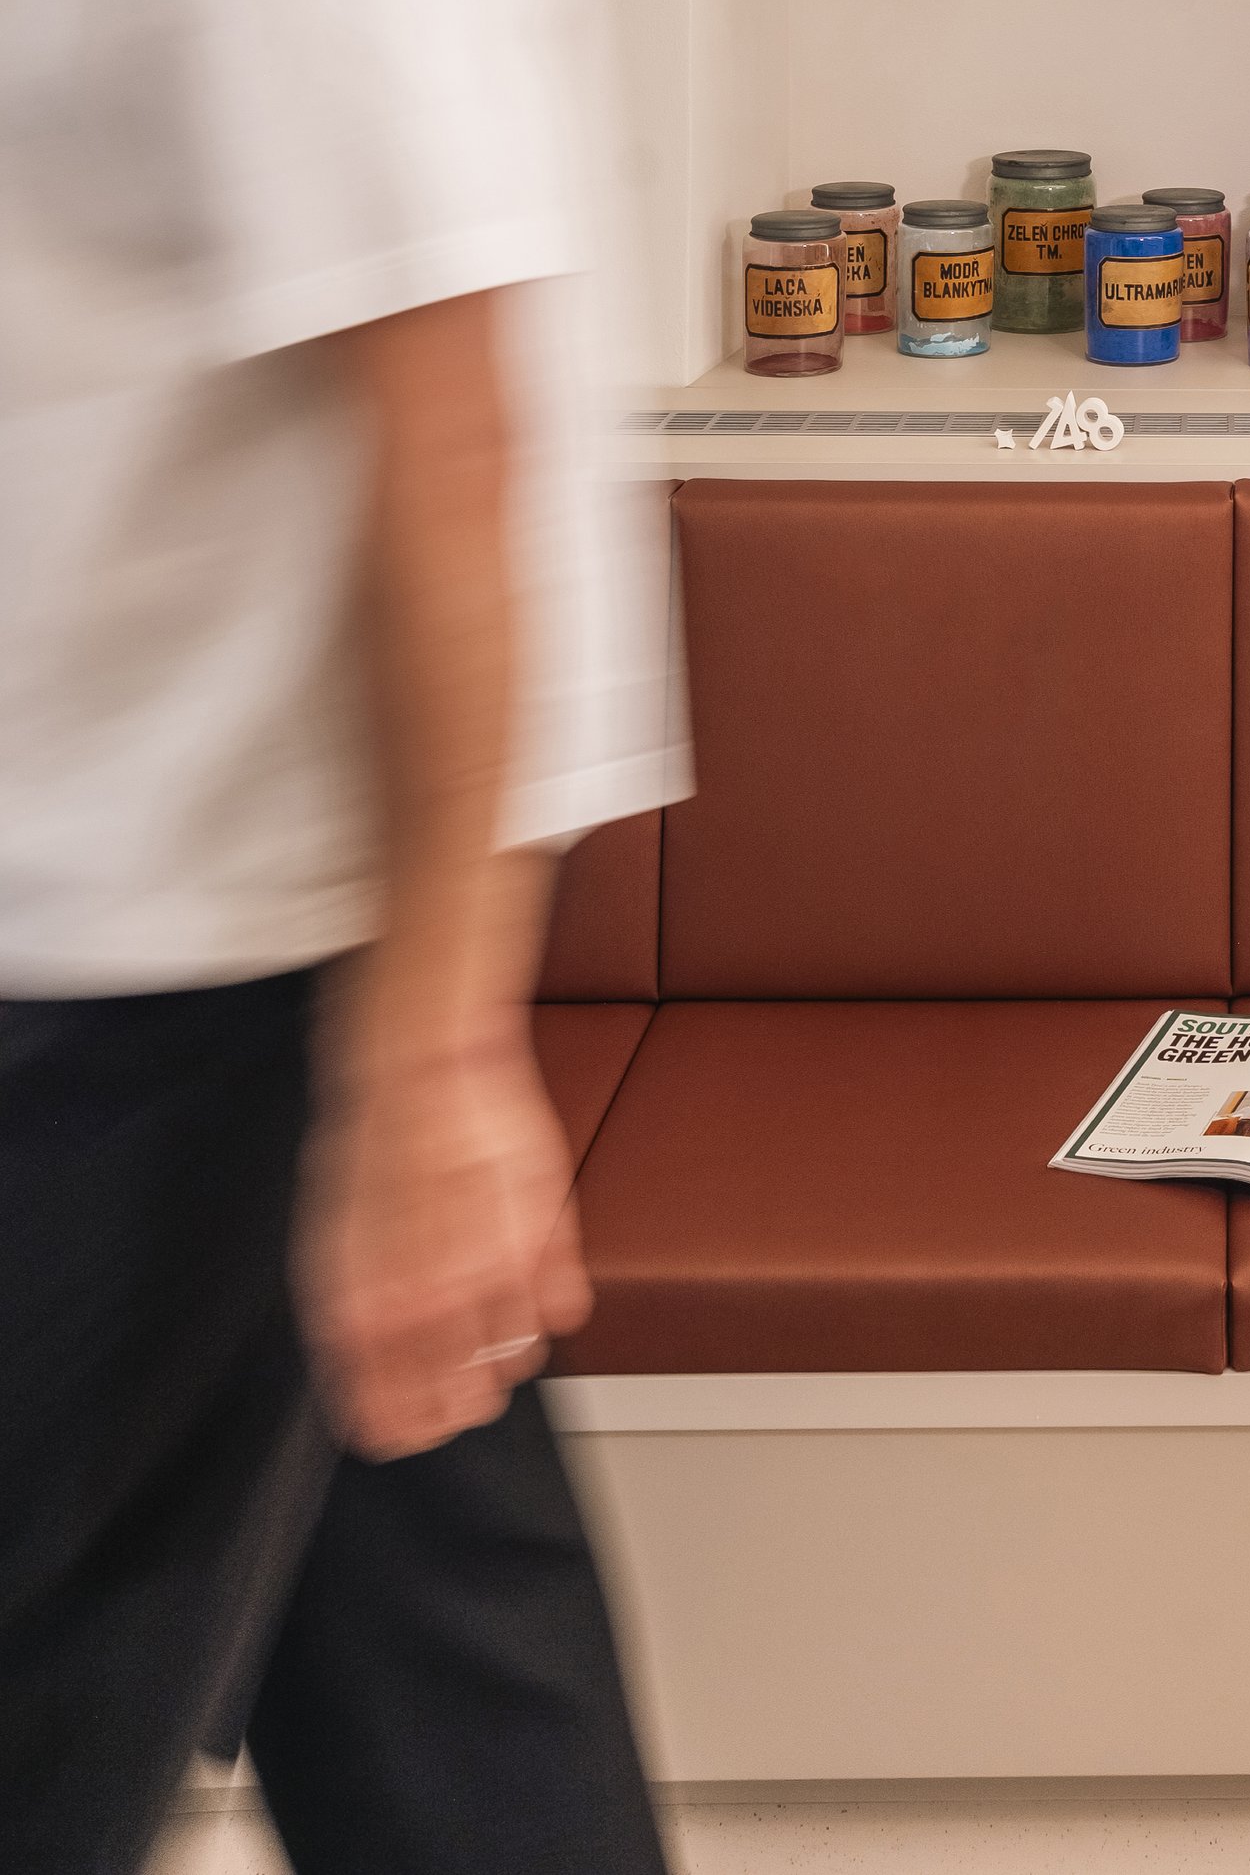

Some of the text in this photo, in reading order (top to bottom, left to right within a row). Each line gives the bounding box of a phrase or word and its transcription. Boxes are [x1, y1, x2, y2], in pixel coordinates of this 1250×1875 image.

[1007, 221, 1088, 242] ZELEŇ CHRO
[1036, 244, 1063, 260] TM.
[940, 257, 980, 280] MODŘ
[1168, 1032, 1224, 1050] THE
[1088, 1143, 1208, 1155] Green industry
